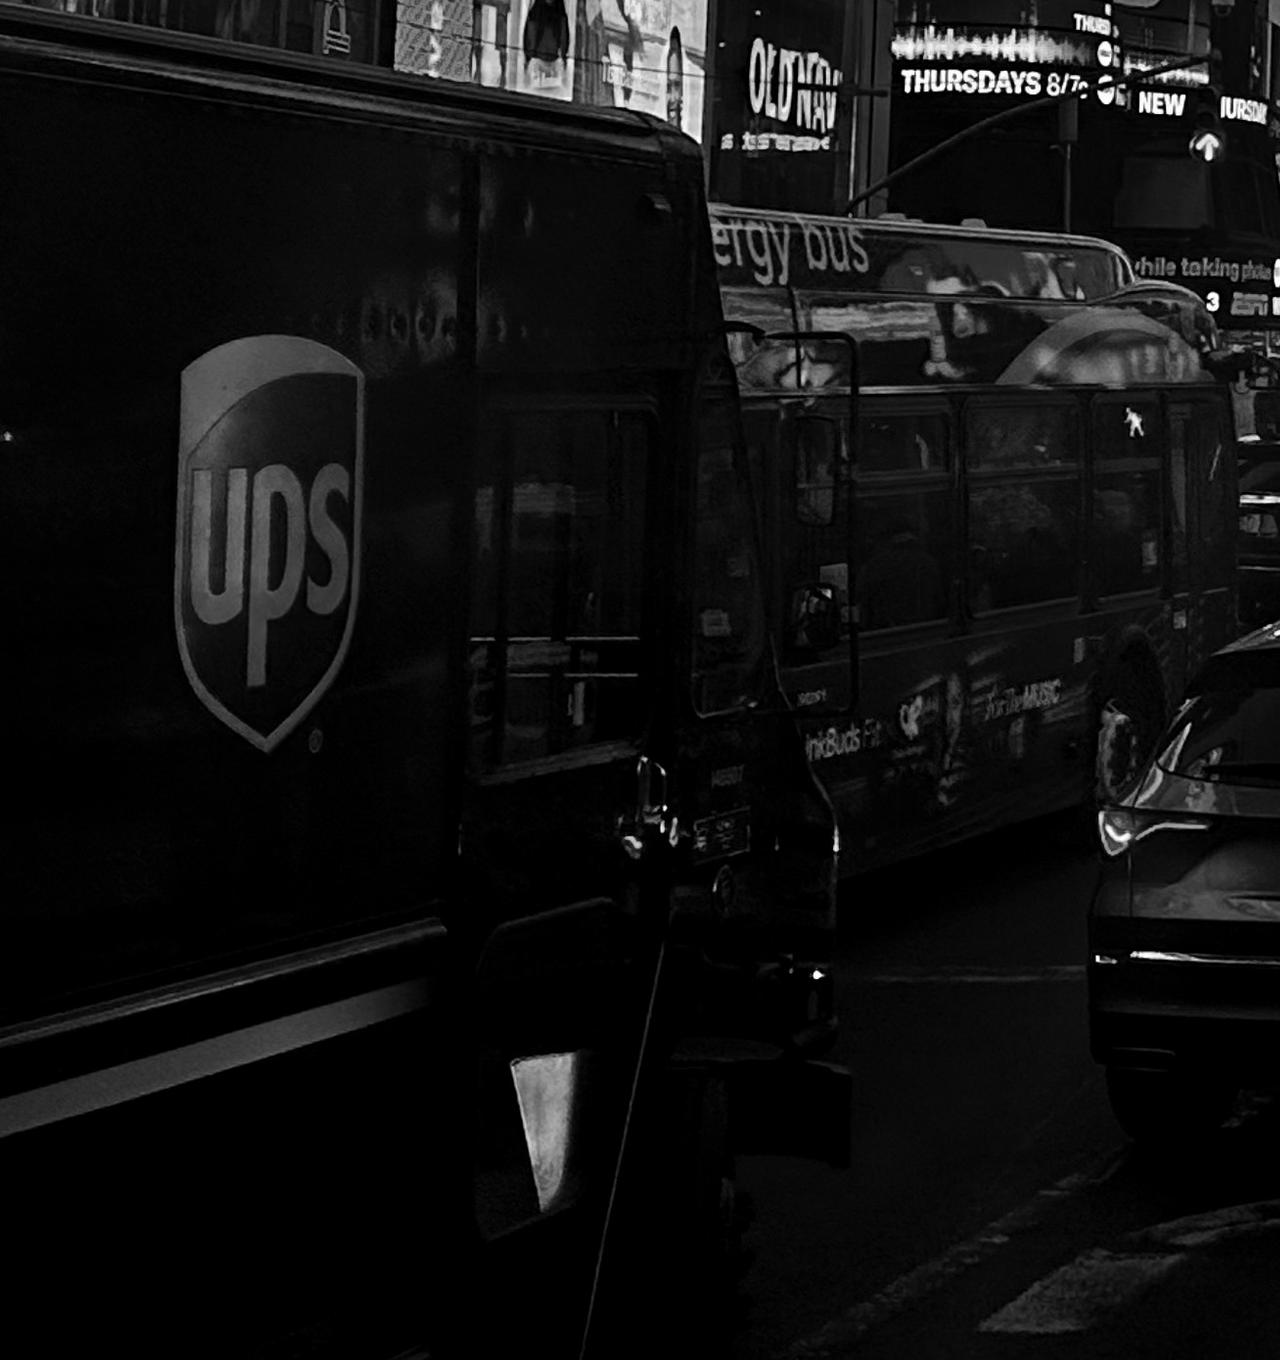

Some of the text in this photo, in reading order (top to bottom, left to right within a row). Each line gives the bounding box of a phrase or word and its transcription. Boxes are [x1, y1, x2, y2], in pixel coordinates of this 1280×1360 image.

[901, 69, 1042, 97] THURSDAYS
[1138, 91, 1187, 118] NEW
[801, 222, 870, 274] bus
[1181, 256, 1240, 283] taking
[190, 462, 351, 687] ups
